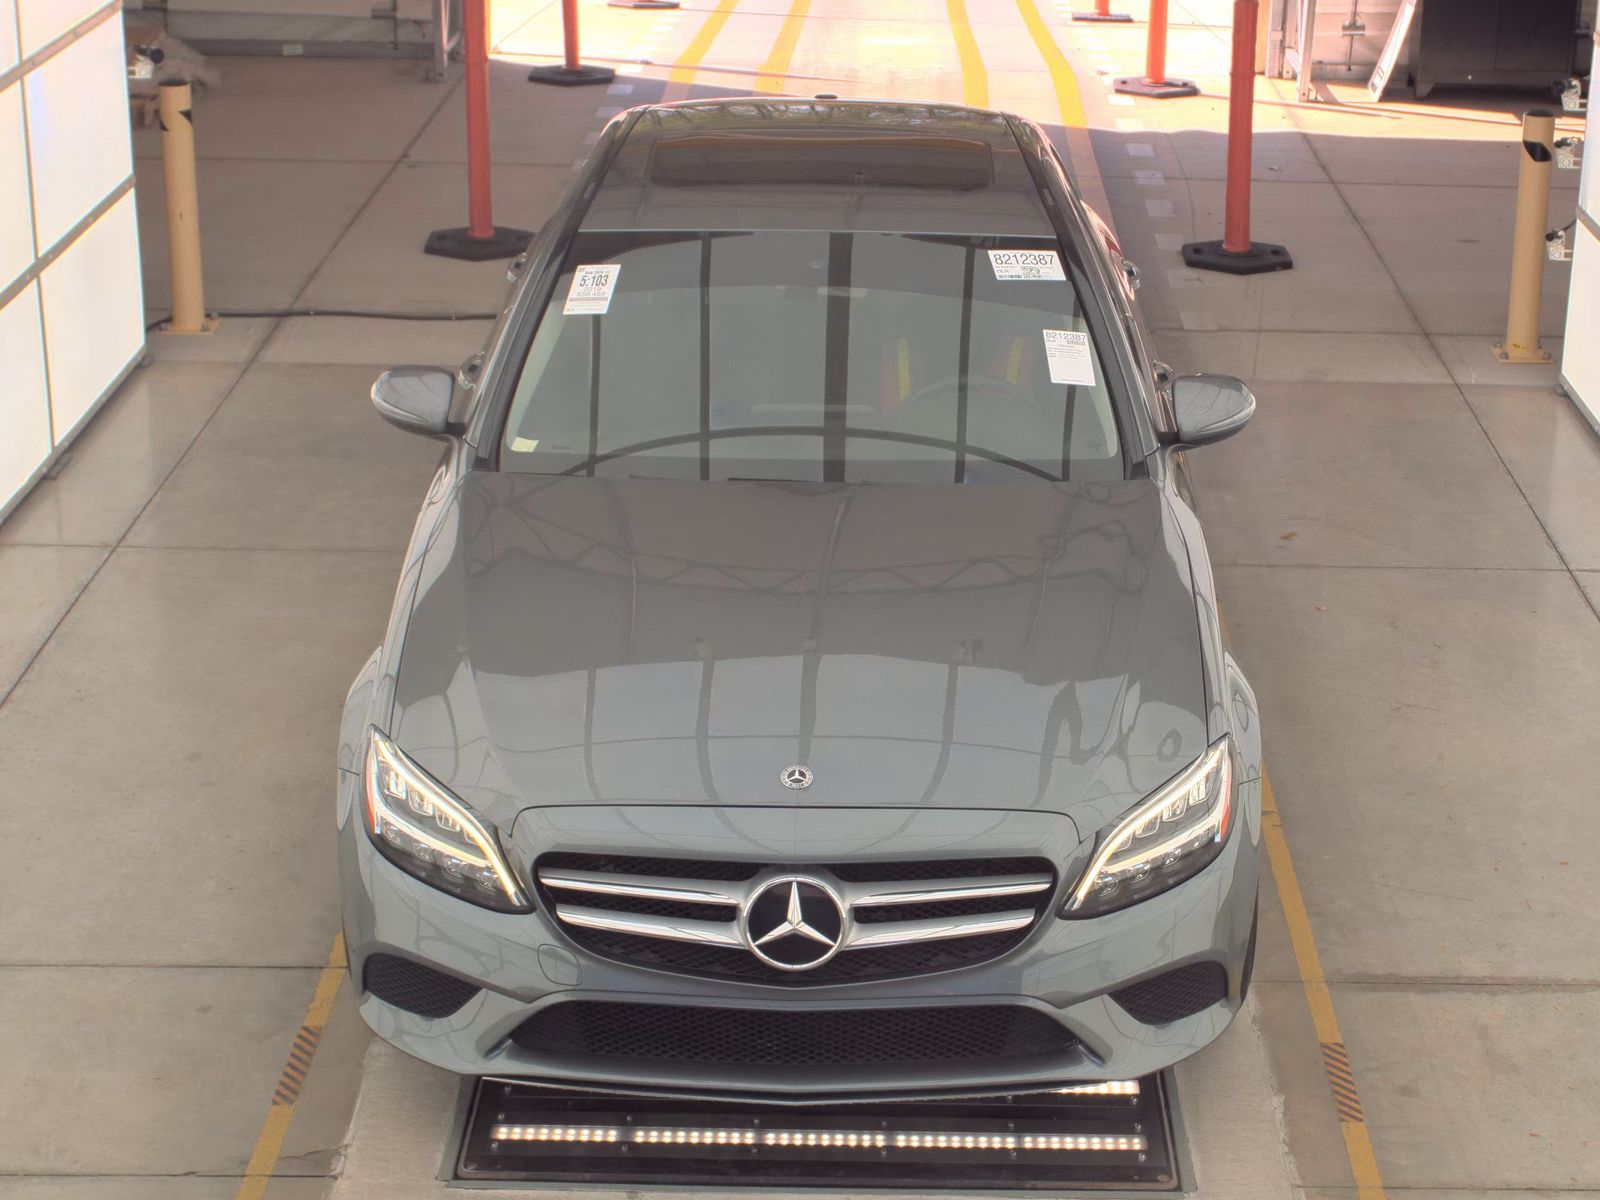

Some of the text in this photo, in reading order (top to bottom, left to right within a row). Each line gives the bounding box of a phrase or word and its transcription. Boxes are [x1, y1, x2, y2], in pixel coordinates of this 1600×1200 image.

[993, 253, 1054, 265] 8212387
[580, 274, 609, 287] 5:103
[1045, 331, 1086, 341] 8212387
